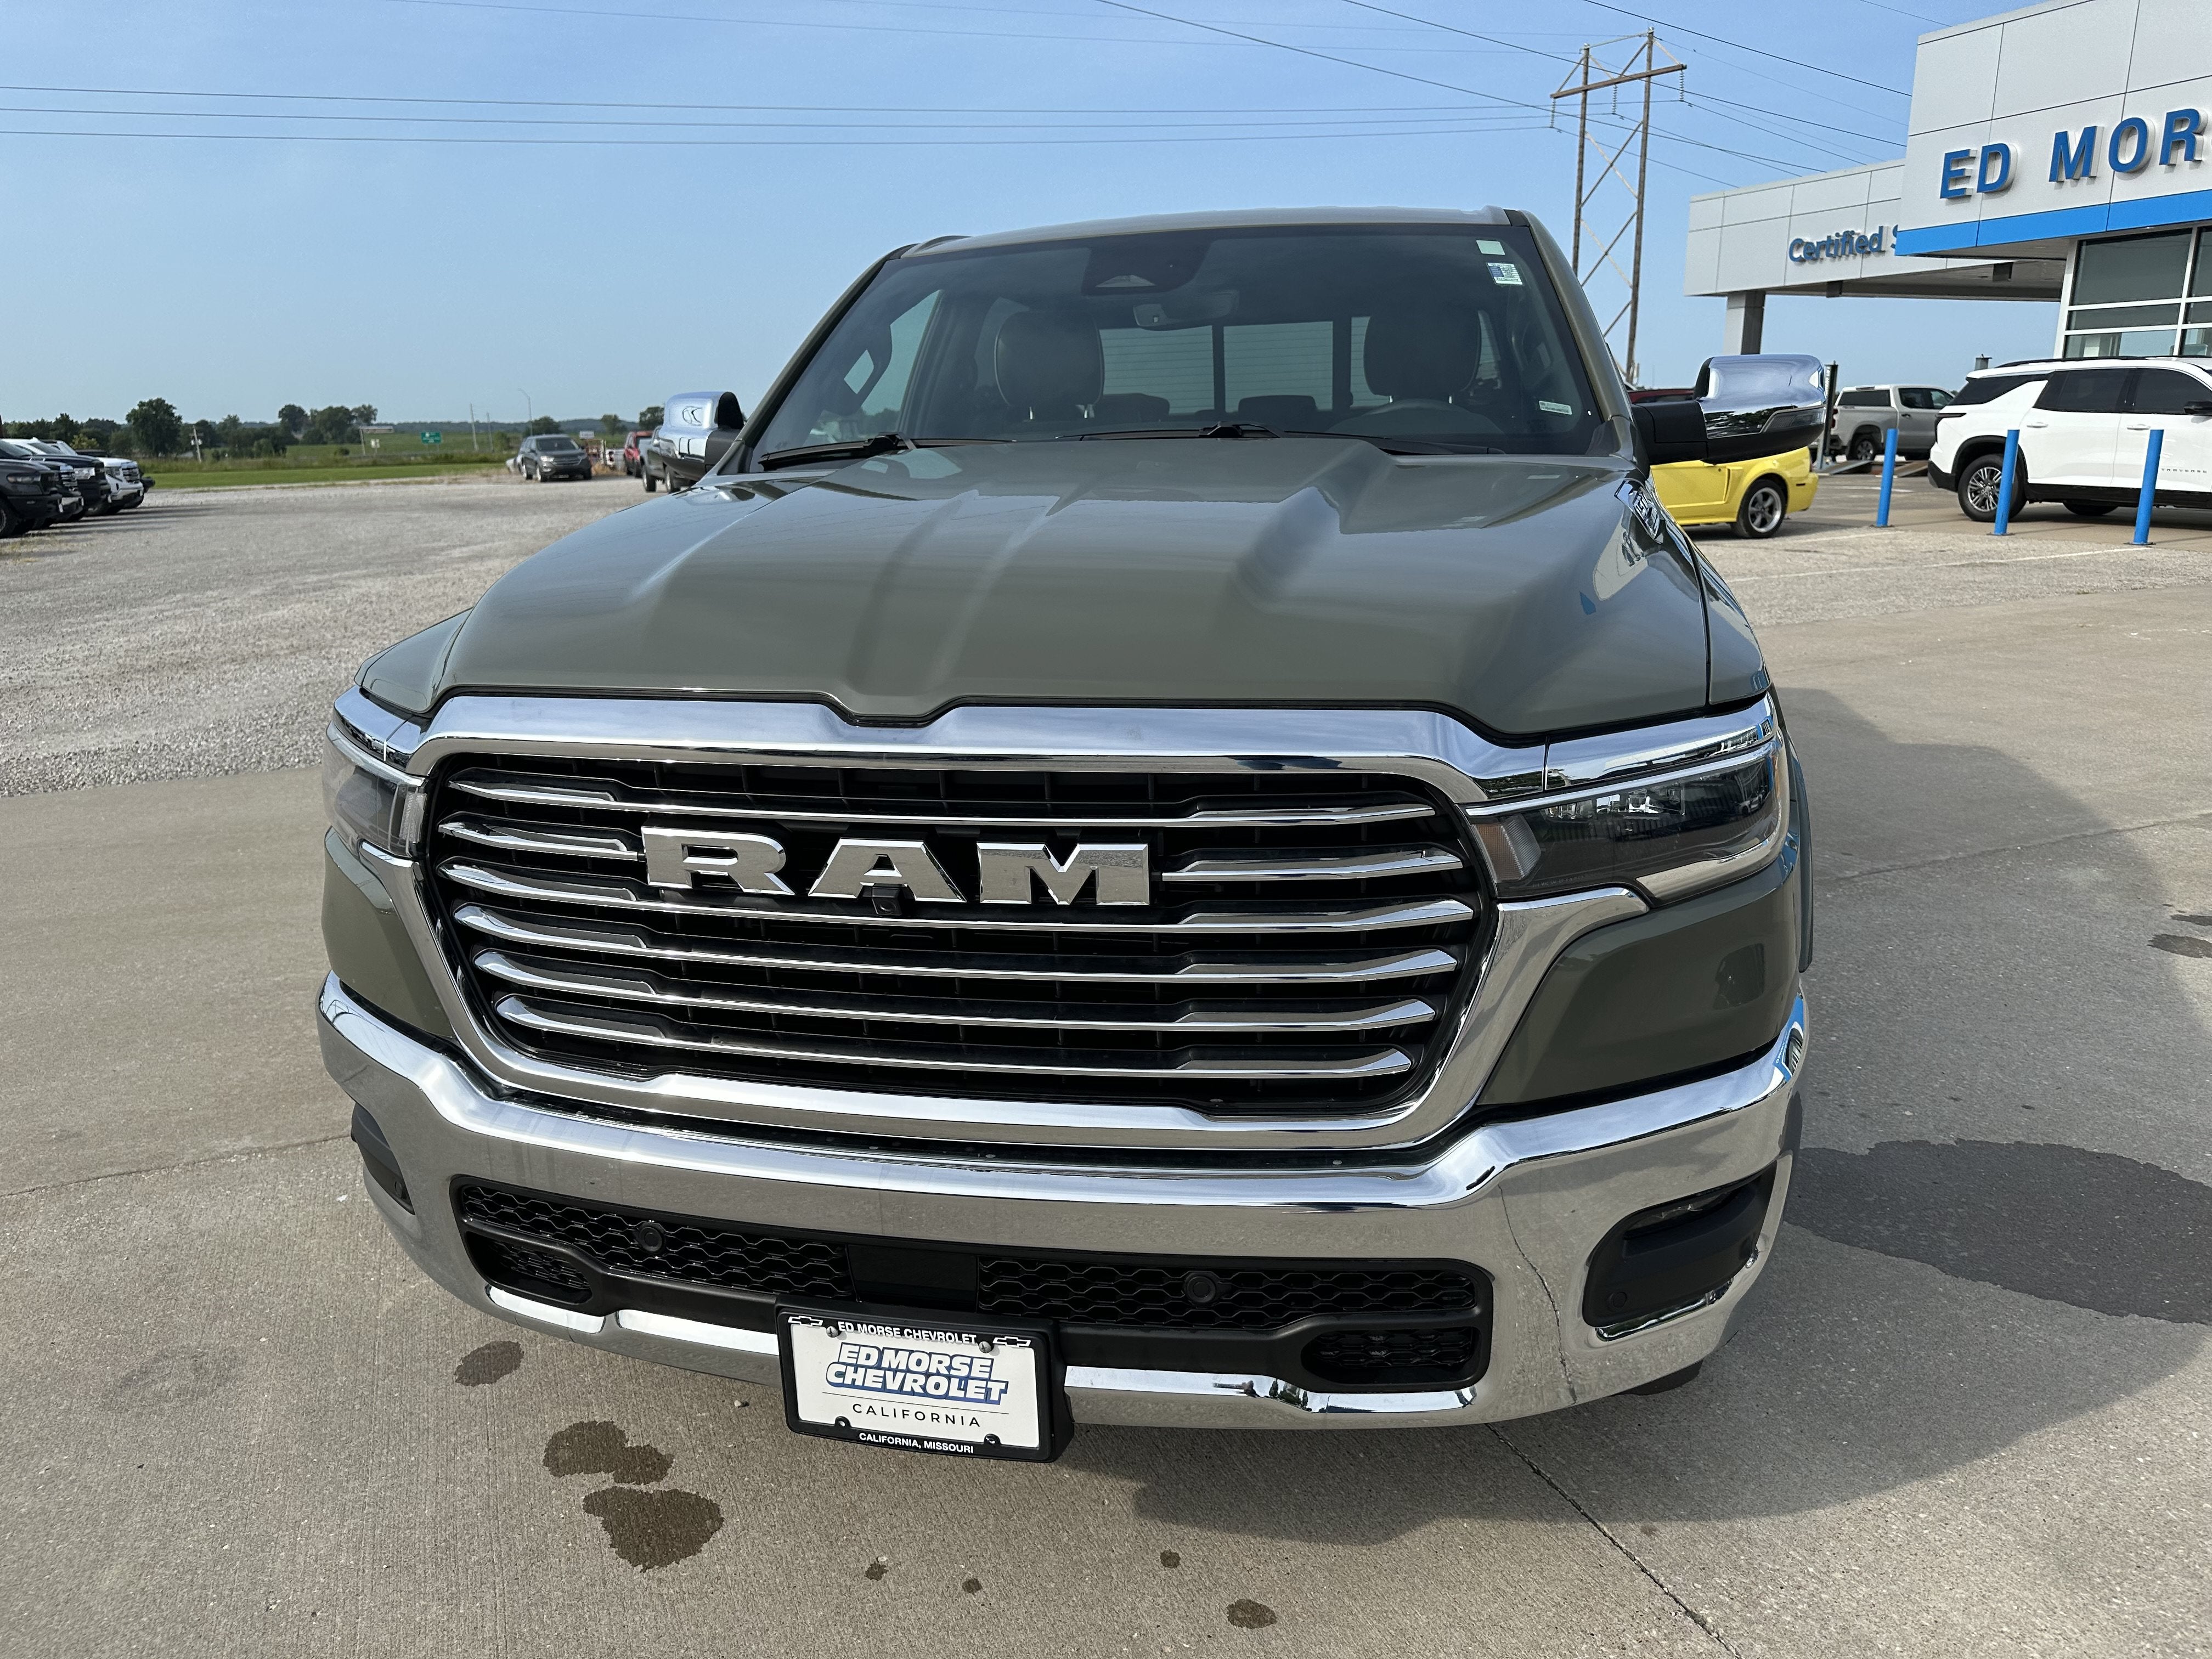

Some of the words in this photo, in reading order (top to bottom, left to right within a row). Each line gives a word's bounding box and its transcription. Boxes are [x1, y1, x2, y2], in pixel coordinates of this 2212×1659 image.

[1940, 143, 2015, 199] ED
[1789, 225, 1885, 262] Certified
[641, 825, 1149, 906] RAM
[838, 1321, 854, 1332] ED
[856, 1323, 901, 1338] MORSE
[904, 1327, 977, 1345] CHEVROLET
[838, 1342, 880, 1367] ED
[881, 1347, 993, 1379] MORSE
[826, 1362, 1008, 1403] CHEVROLET
[853, 1403, 980, 1427] CALIFORNIA
[859, 1432, 922, 1449] CALIFORNIA,
[924, 1440, 974, 1454] MISSOURI
